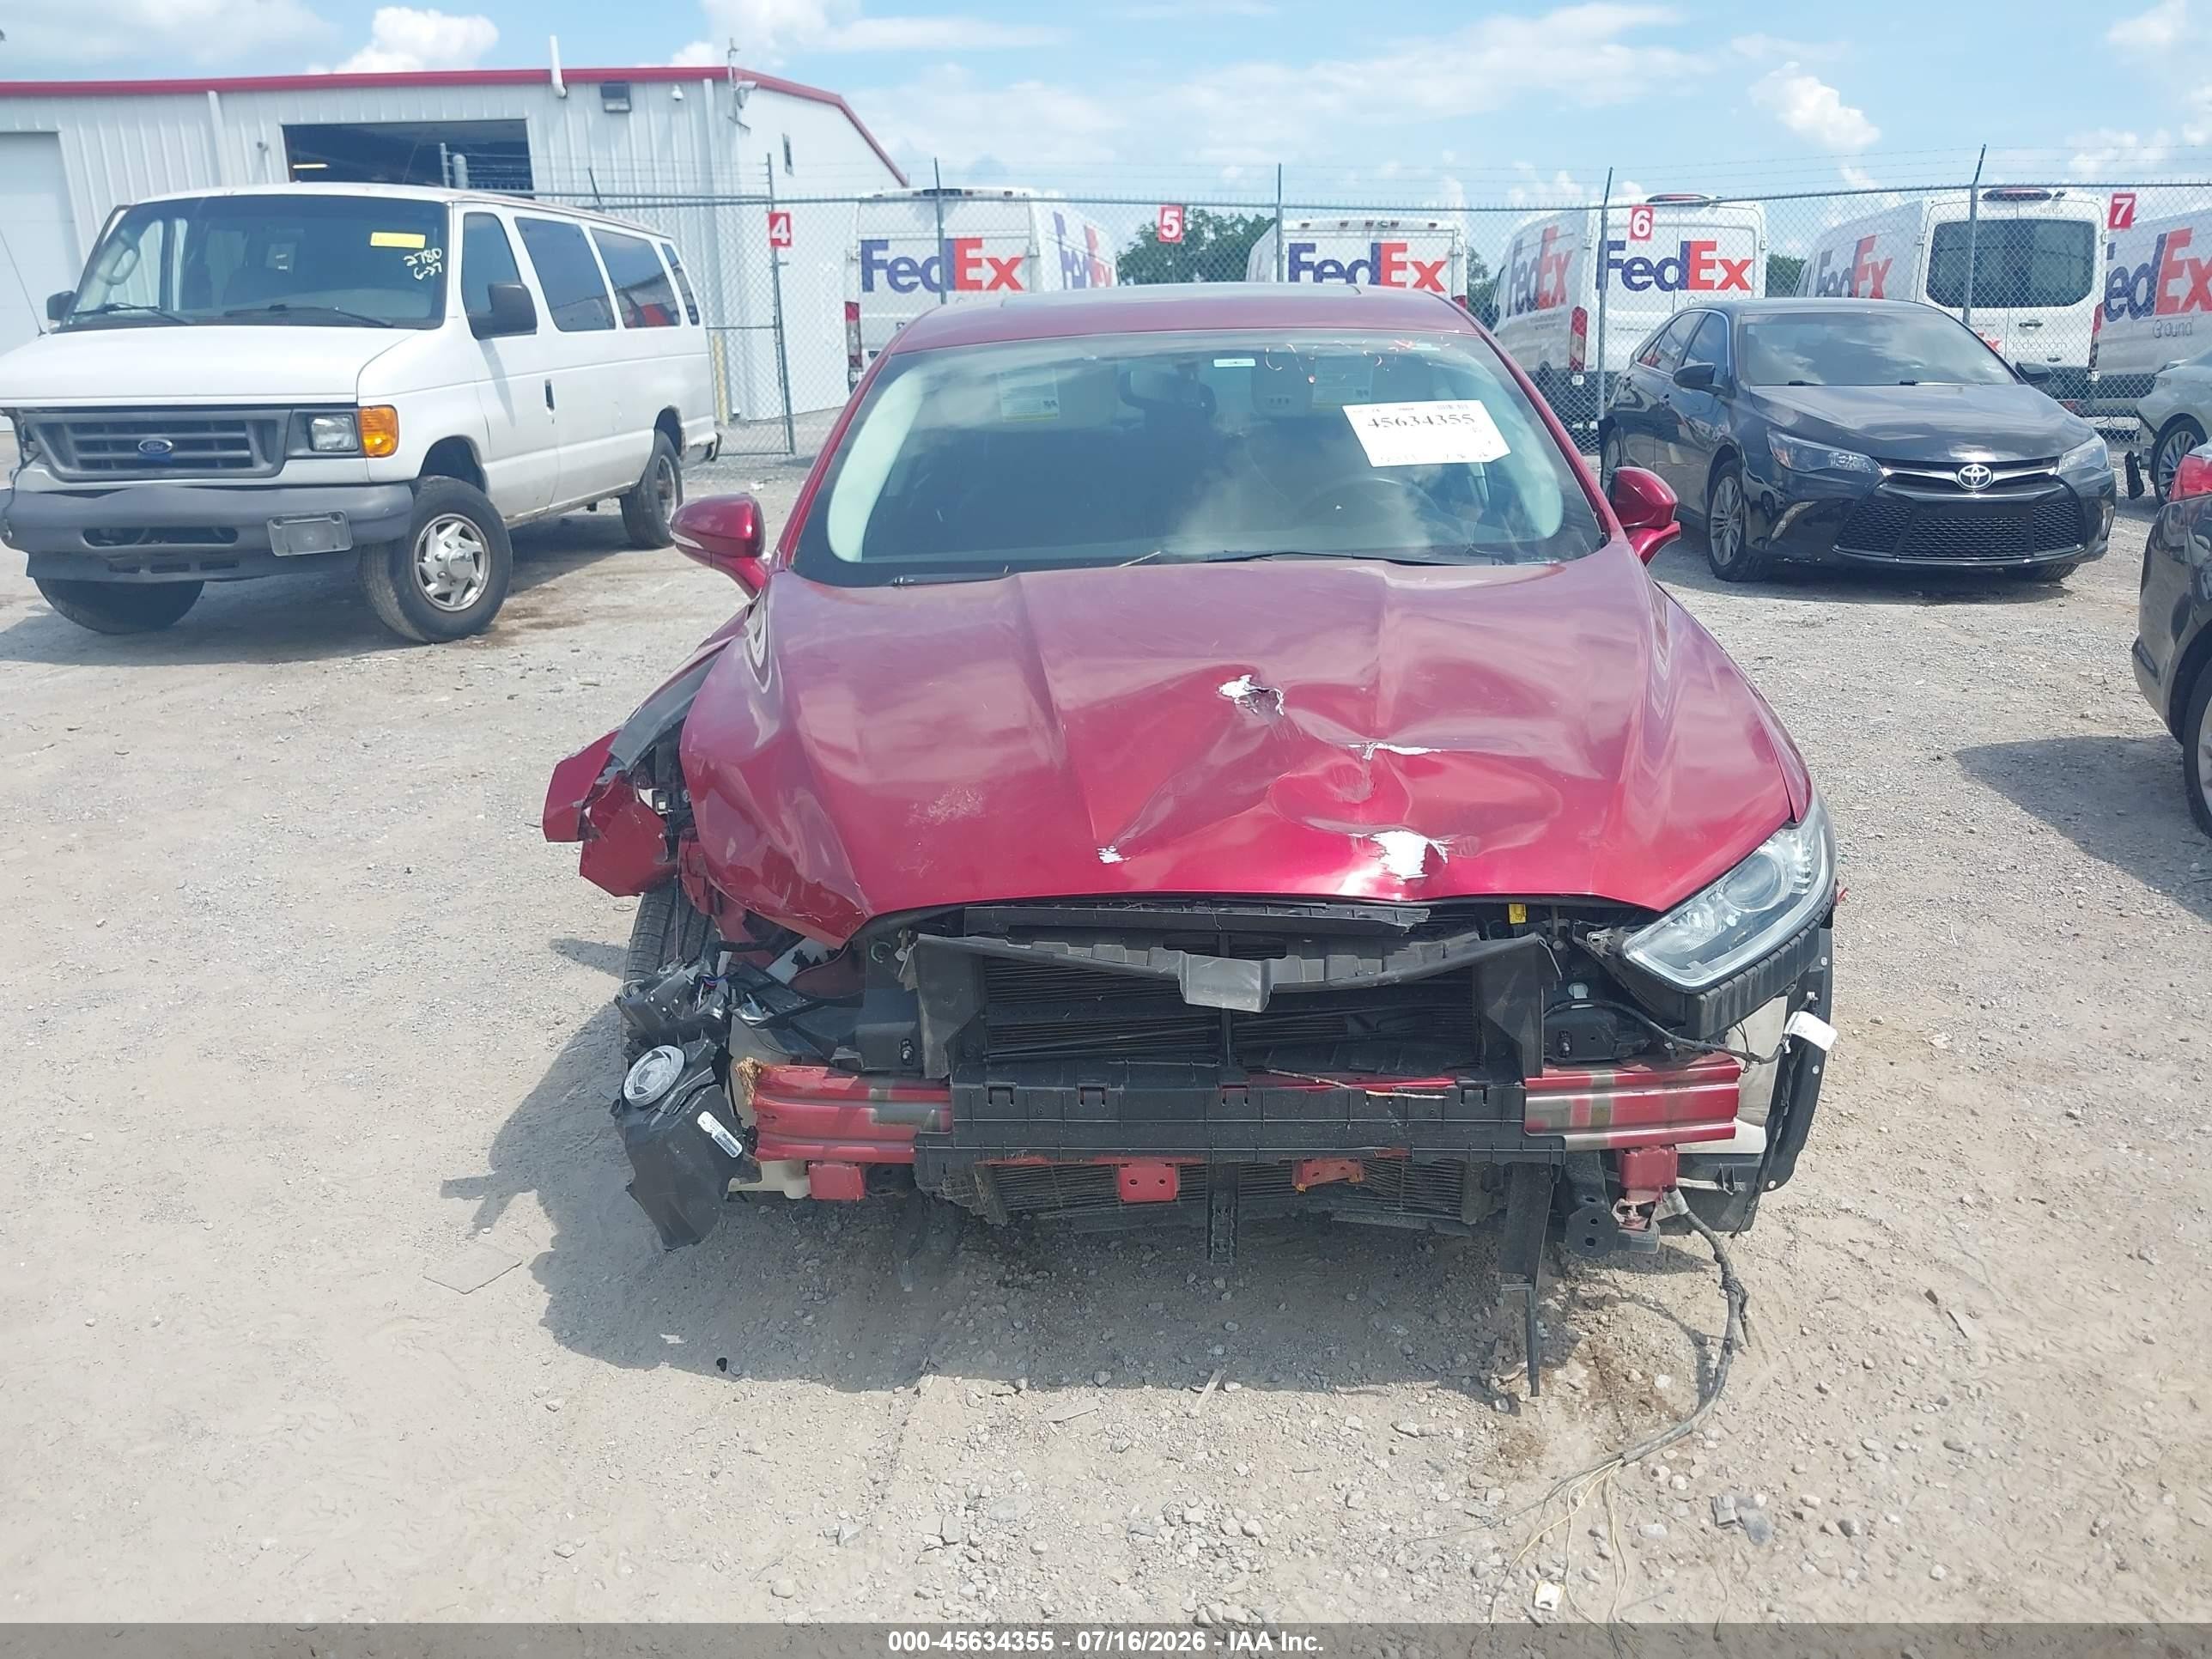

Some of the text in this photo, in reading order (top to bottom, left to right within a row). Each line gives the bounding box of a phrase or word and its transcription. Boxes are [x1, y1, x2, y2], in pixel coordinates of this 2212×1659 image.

[1161, 210, 1181, 239] 5
[1632, 210, 1650, 237] 6
[2113, 198, 2133, 225] 7
[772, 216, 790, 244] 4
[860, 237, 1024, 293] FedEx
[1289, 242, 1446, 292] FedEx
[1507, 225, 1573, 318] FedEx
[1595, 240, 1753, 292] FedEx
[1367, 414, 1475, 428] 45634355
